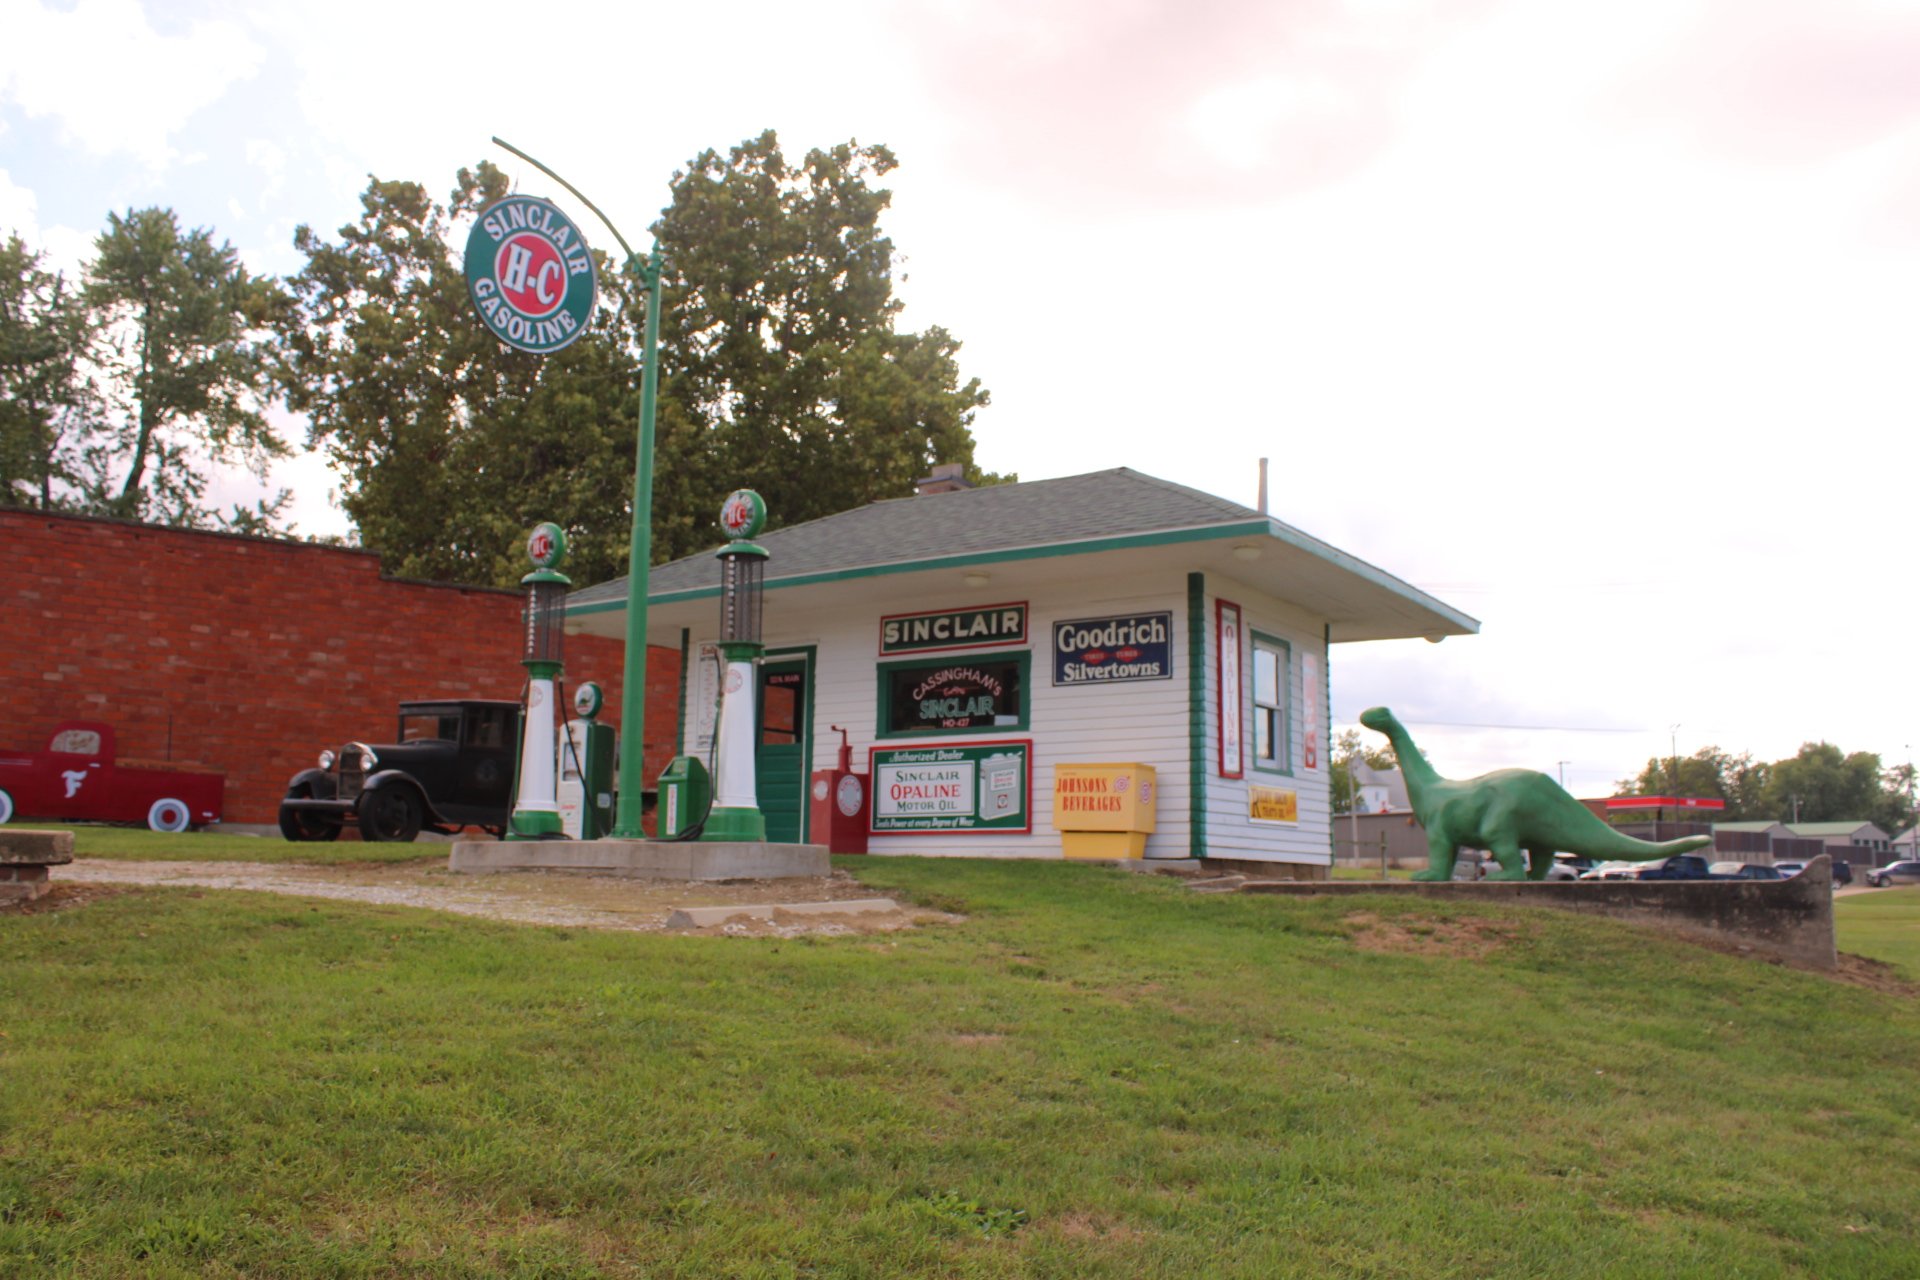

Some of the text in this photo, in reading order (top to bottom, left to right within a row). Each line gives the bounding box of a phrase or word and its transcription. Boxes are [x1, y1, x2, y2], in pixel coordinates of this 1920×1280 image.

[484, 203, 589, 277] SINCLAIR
[502, 243, 560, 305] H-C
[475, 277, 577, 344] GASOLINE
[884, 610, 1020, 644] SINCLAIR
[1058, 617, 1166, 653] Goodrich
[1063, 661, 1160, 682] Silvertowns
[920, 695, 995, 720] SINCLAIR
[888, 749, 964, 763] Authorized Dealer
[61, 769, 87, 798] F
[895, 770, 961, 783] SINCLAIR
[890, 783, 962, 801] OPALINE
[1062, 795, 1122, 812] BEVERAGES
[896, 800, 958, 812] MOTOR OIL
